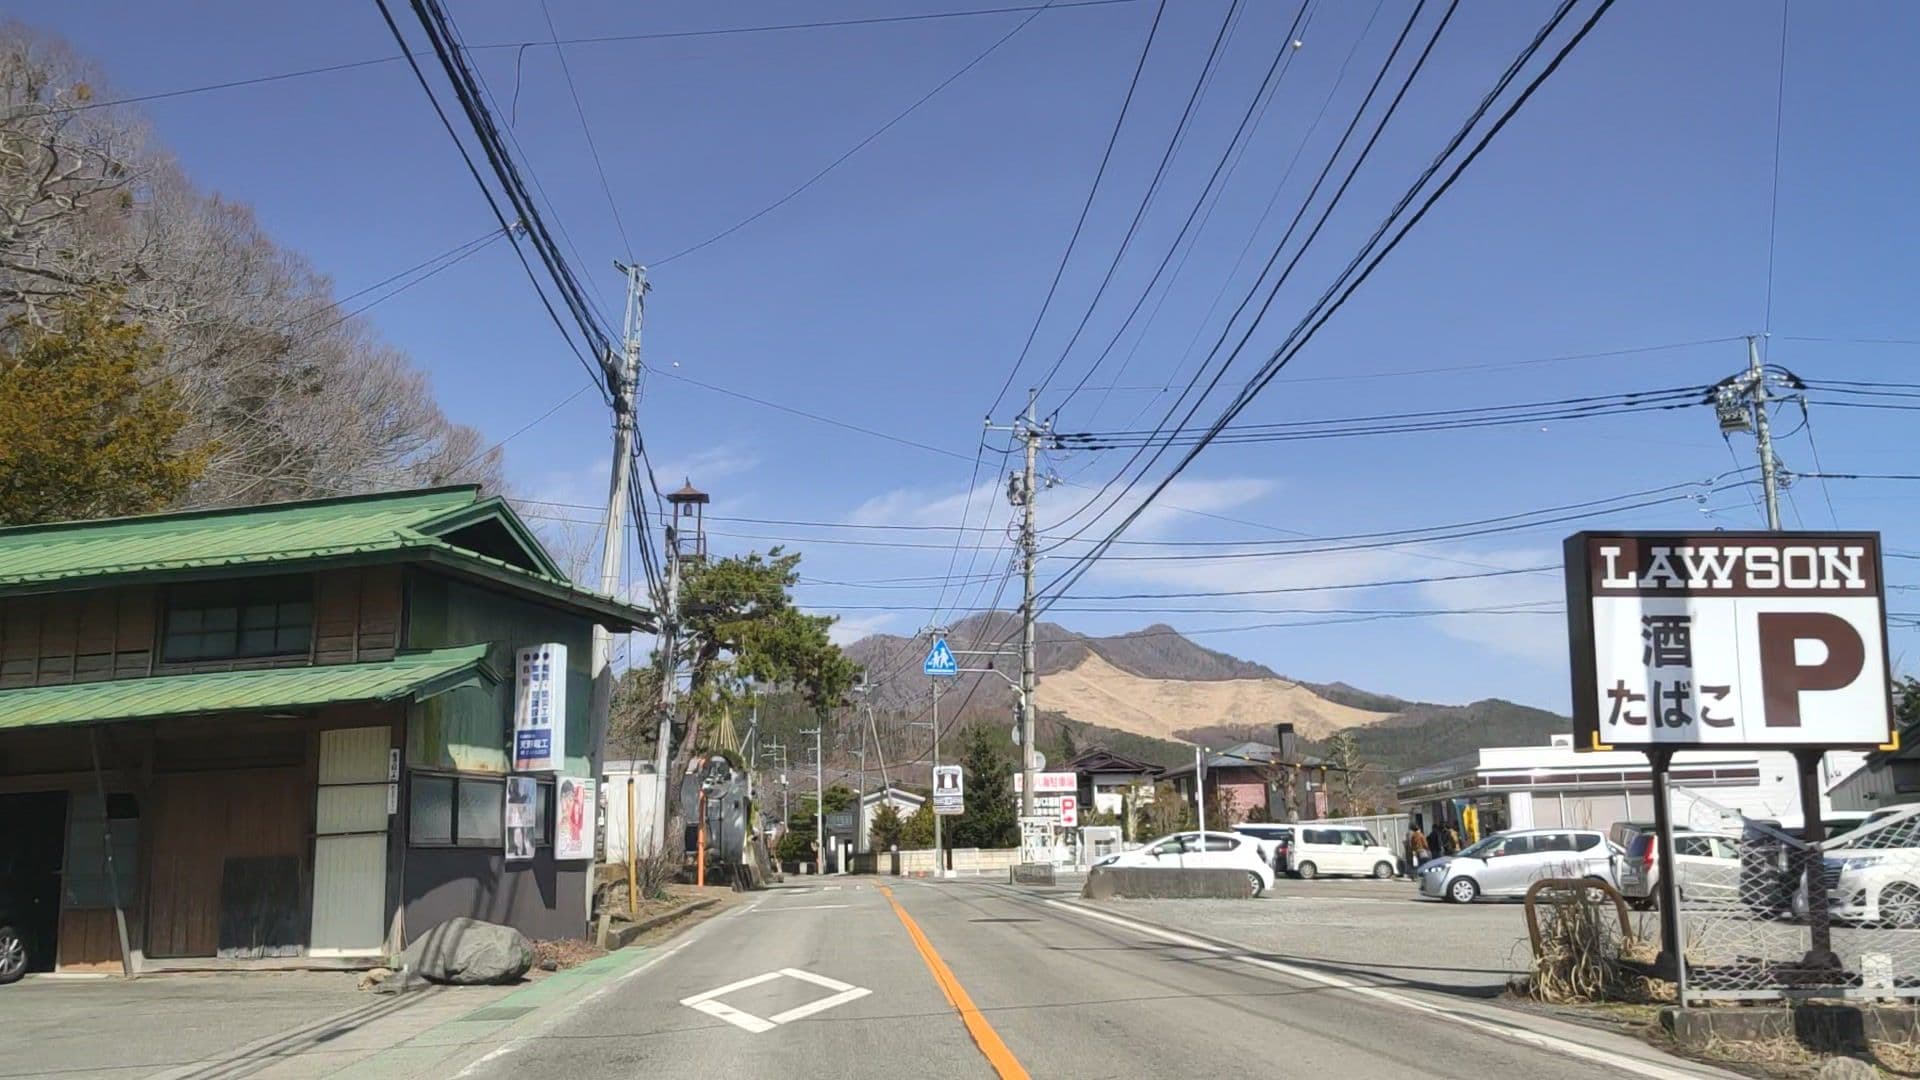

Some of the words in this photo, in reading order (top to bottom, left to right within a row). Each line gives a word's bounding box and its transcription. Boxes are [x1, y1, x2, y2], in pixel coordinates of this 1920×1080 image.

[1600, 546, 1866, 589] LAWSON
[1641, 614, 1692, 669] 酒
[1758, 611, 1865, 728] P
[1607, 679, 1735, 729] たばこ
[1062, 799, 1075, 815] P
